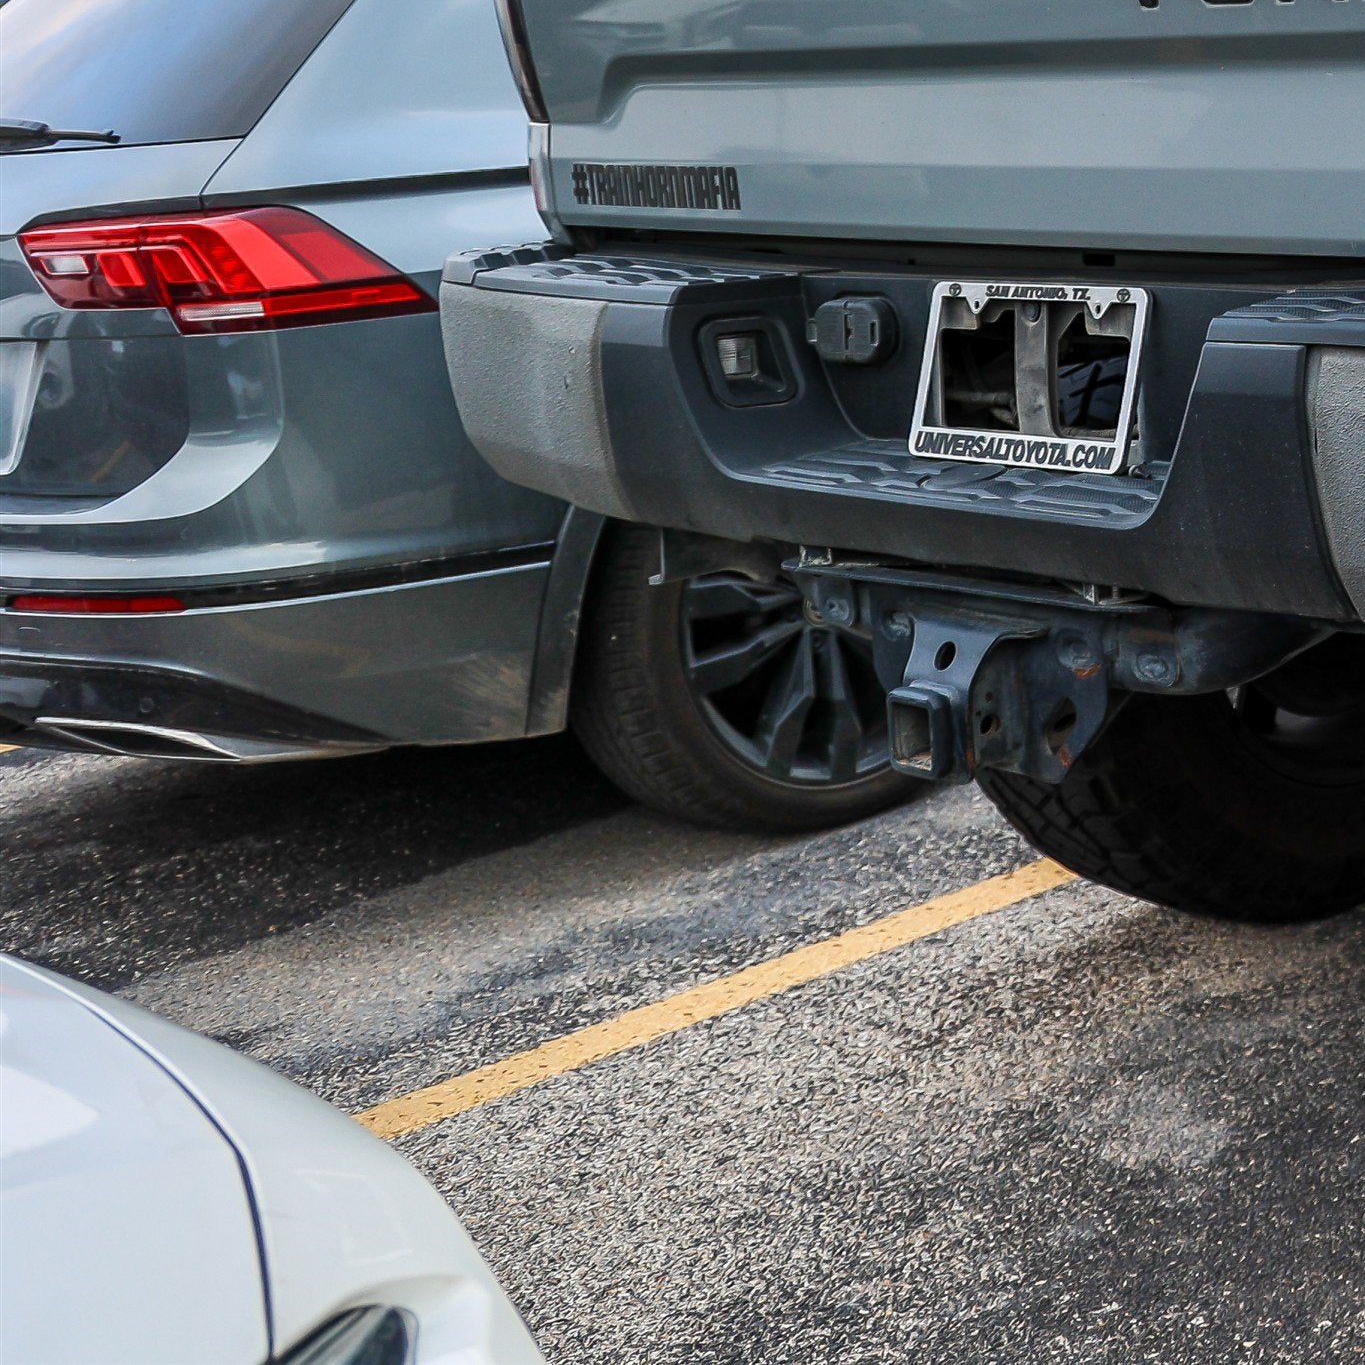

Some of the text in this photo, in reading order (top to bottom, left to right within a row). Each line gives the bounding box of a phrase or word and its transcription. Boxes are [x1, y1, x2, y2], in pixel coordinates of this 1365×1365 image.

[985, 285, 1010, 298] SAN
[1011, 286, 1068, 300] ANTONIO,
[914, 431, 1116, 471] UNIVERSALTOYOTA.COM
